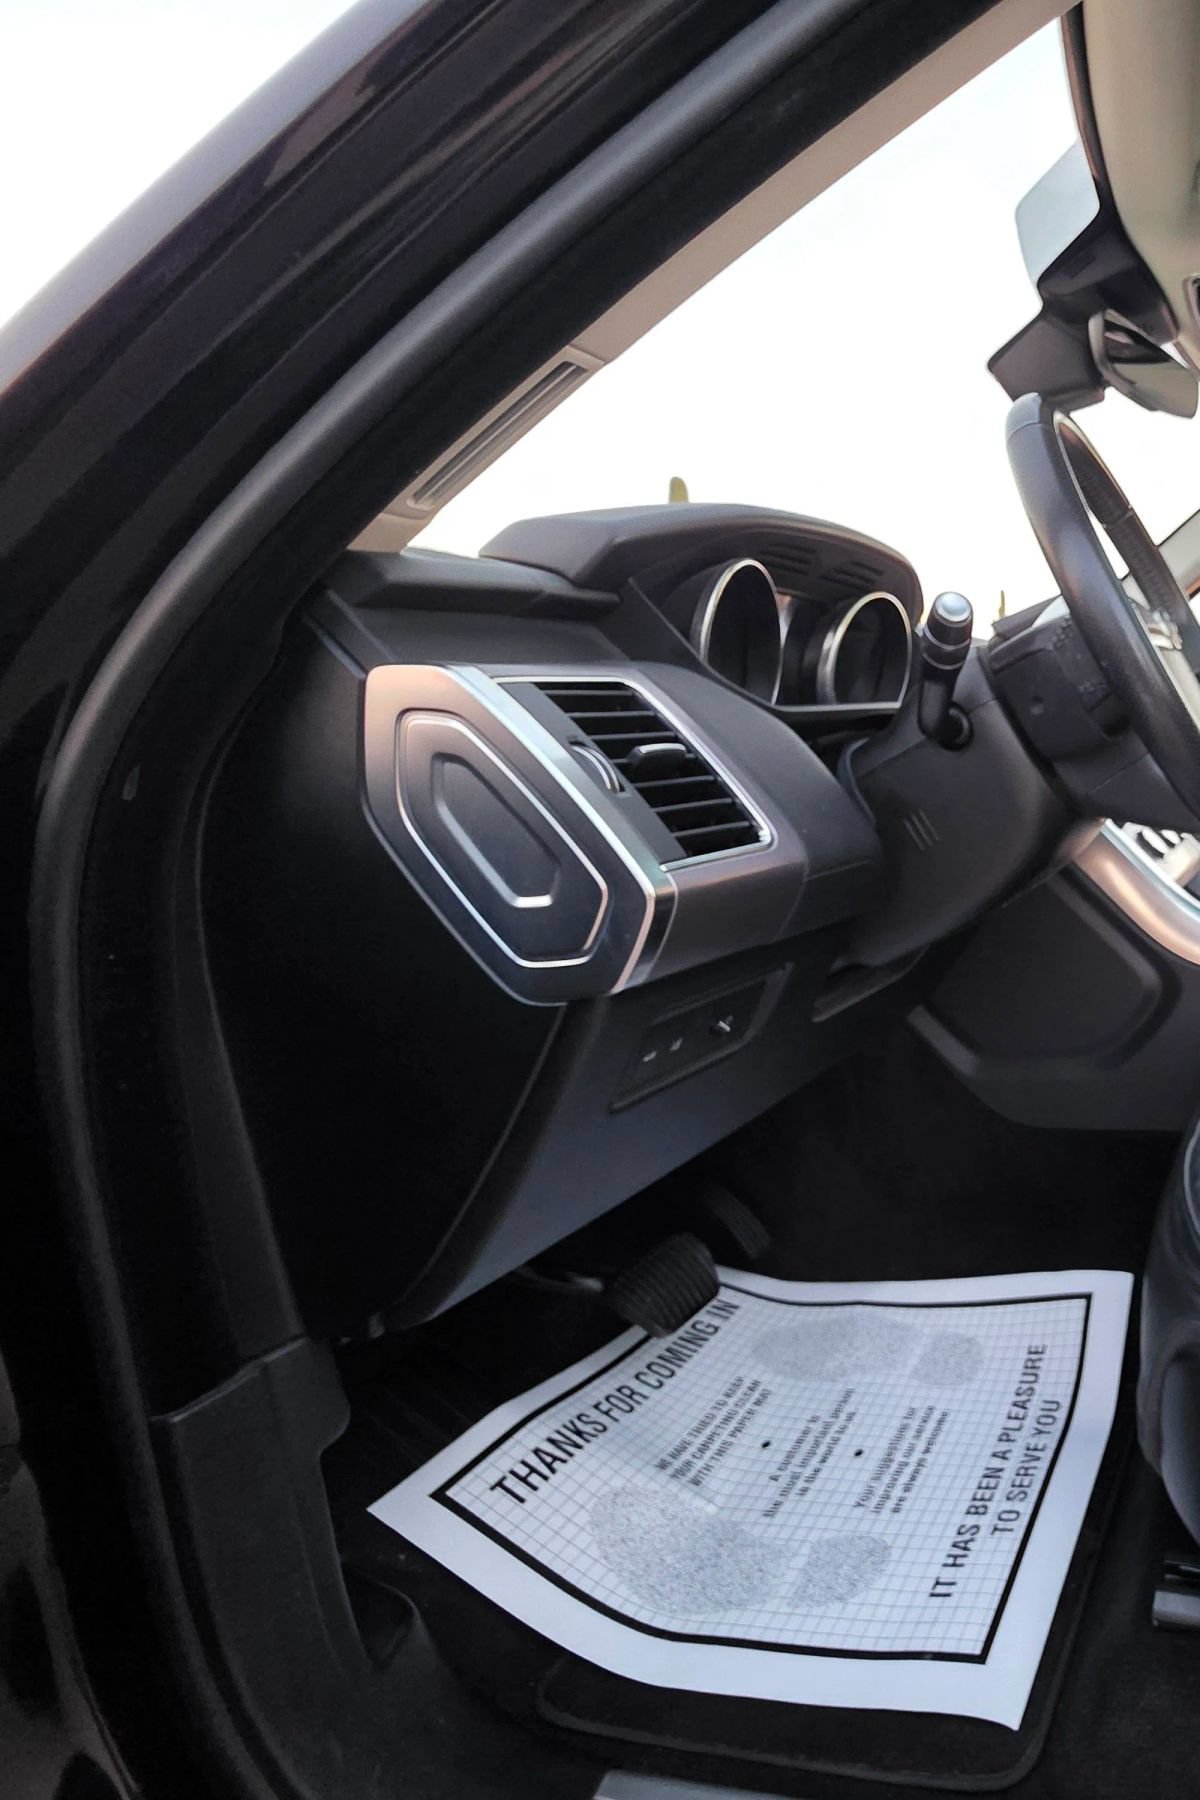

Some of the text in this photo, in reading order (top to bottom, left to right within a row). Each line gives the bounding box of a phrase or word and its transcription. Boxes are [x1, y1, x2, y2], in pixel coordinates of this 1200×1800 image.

[489, 1299, 740, 1504] THANKS FOR COMING IN
[687, 1412, 717, 1438] TRIED
[688, 1462, 715, 1487] WITH
[710, 1440, 734, 1461] THIS
[728, 1408, 755, 1438] PAPER
[669, 1459, 697, 1480] YOUR
[929, 1344, 1047, 1598] IT HAS BEEN A PLEASURE
[990, 1399, 1062, 1535] TO SERVE YOU
